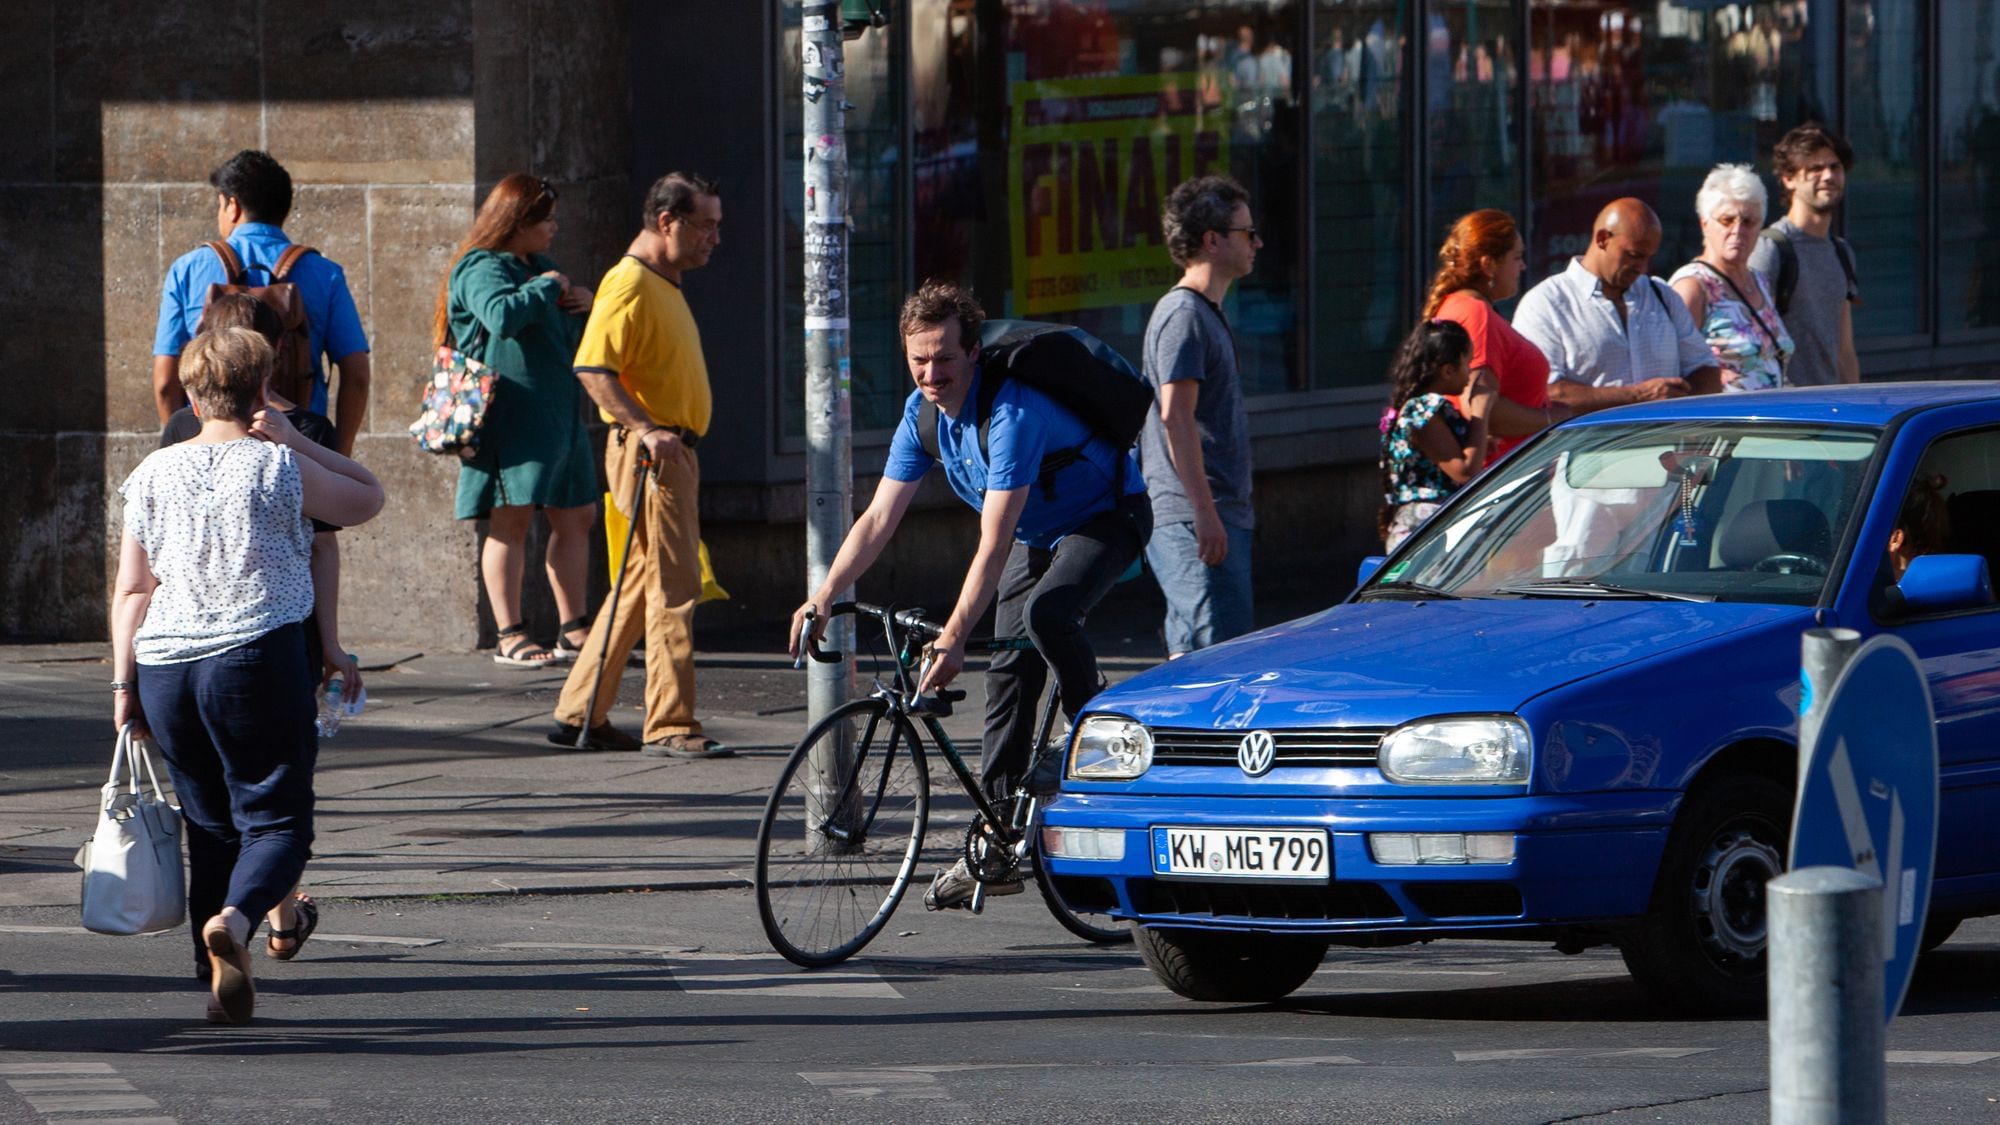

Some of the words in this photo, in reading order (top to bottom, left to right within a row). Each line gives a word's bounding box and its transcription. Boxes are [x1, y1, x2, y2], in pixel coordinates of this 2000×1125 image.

[1238, 729, 1273, 774] VW
[1171, 833, 1205, 868] KW
[1226, 835, 1263, 870] MG
[1269, 837, 1324, 872] 799
